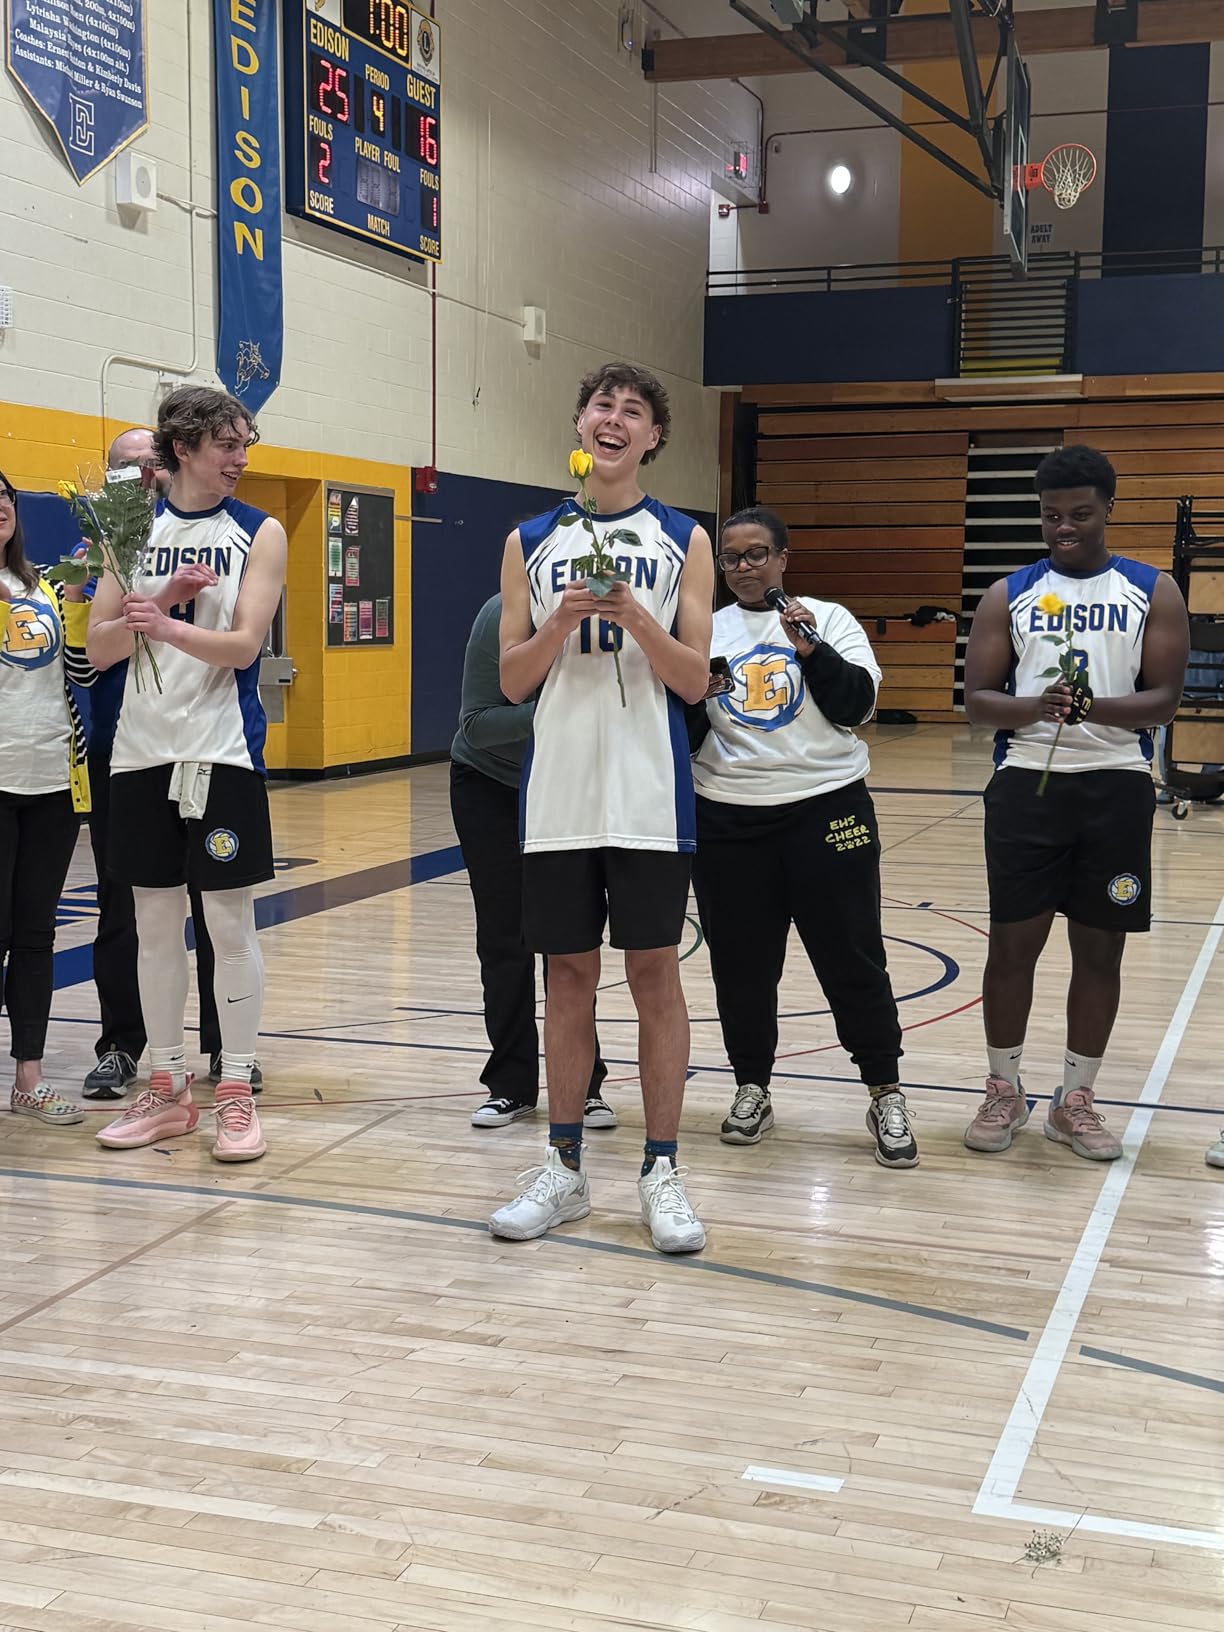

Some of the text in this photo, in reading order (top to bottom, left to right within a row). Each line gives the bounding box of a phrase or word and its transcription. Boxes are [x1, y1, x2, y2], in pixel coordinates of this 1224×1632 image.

[29, 17, 67, 42] Malaysia
[86, 14, 119, 39] (4x100m)
[310, 17, 350, 62] EDISON
[15, 28, 46, 49] Coaches:
[87, 62, 95, 72] &
[95, 65, 123, 87] Kimberly
[124, 78, 142, 94] Davis
[101, 36, 131, 61] (4x100m)
[15, 44, 54, 68] Assistants:
[74, 71, 93, 88] Miller
[94, 80, 100, 90] &
[101, 83, 116, 97] Ryan
[116, 90, 143, 109] Swanson
[319, 60, 348, 121] 25
[365, 63, 390, 91] PERIOD
[406, 73, 436, 109] GUEST
[69, 93, 95, 156] E
[309, 114, 334, 141] FOULS
[372, 95, 384, 132] 4
[231, 0, 264, 261] EDISON
[419, 115, 437, 165] 16
[319, 142, 331, 183] 2
[355, 136, 401, 173] PLAYER FOUL
[420, 168, 439, 191] FOULS
[309, 190, 334, 214] SCORE
[432, 197, 437, 228] 1
[367, 213, 390, 237] MATCH
[419, 234, 440, 256] SCORE
[144, 546, 231, 576] EDISON
[551, 555, 658, 593] EDON
[7, 610, 49, 652] E
[1029, 603, 1128, 632] EDISON
[742, 659, 787, 712] E
[825, 825, 870, 843] CHEER
[830, 815, 855, 830] EHS
